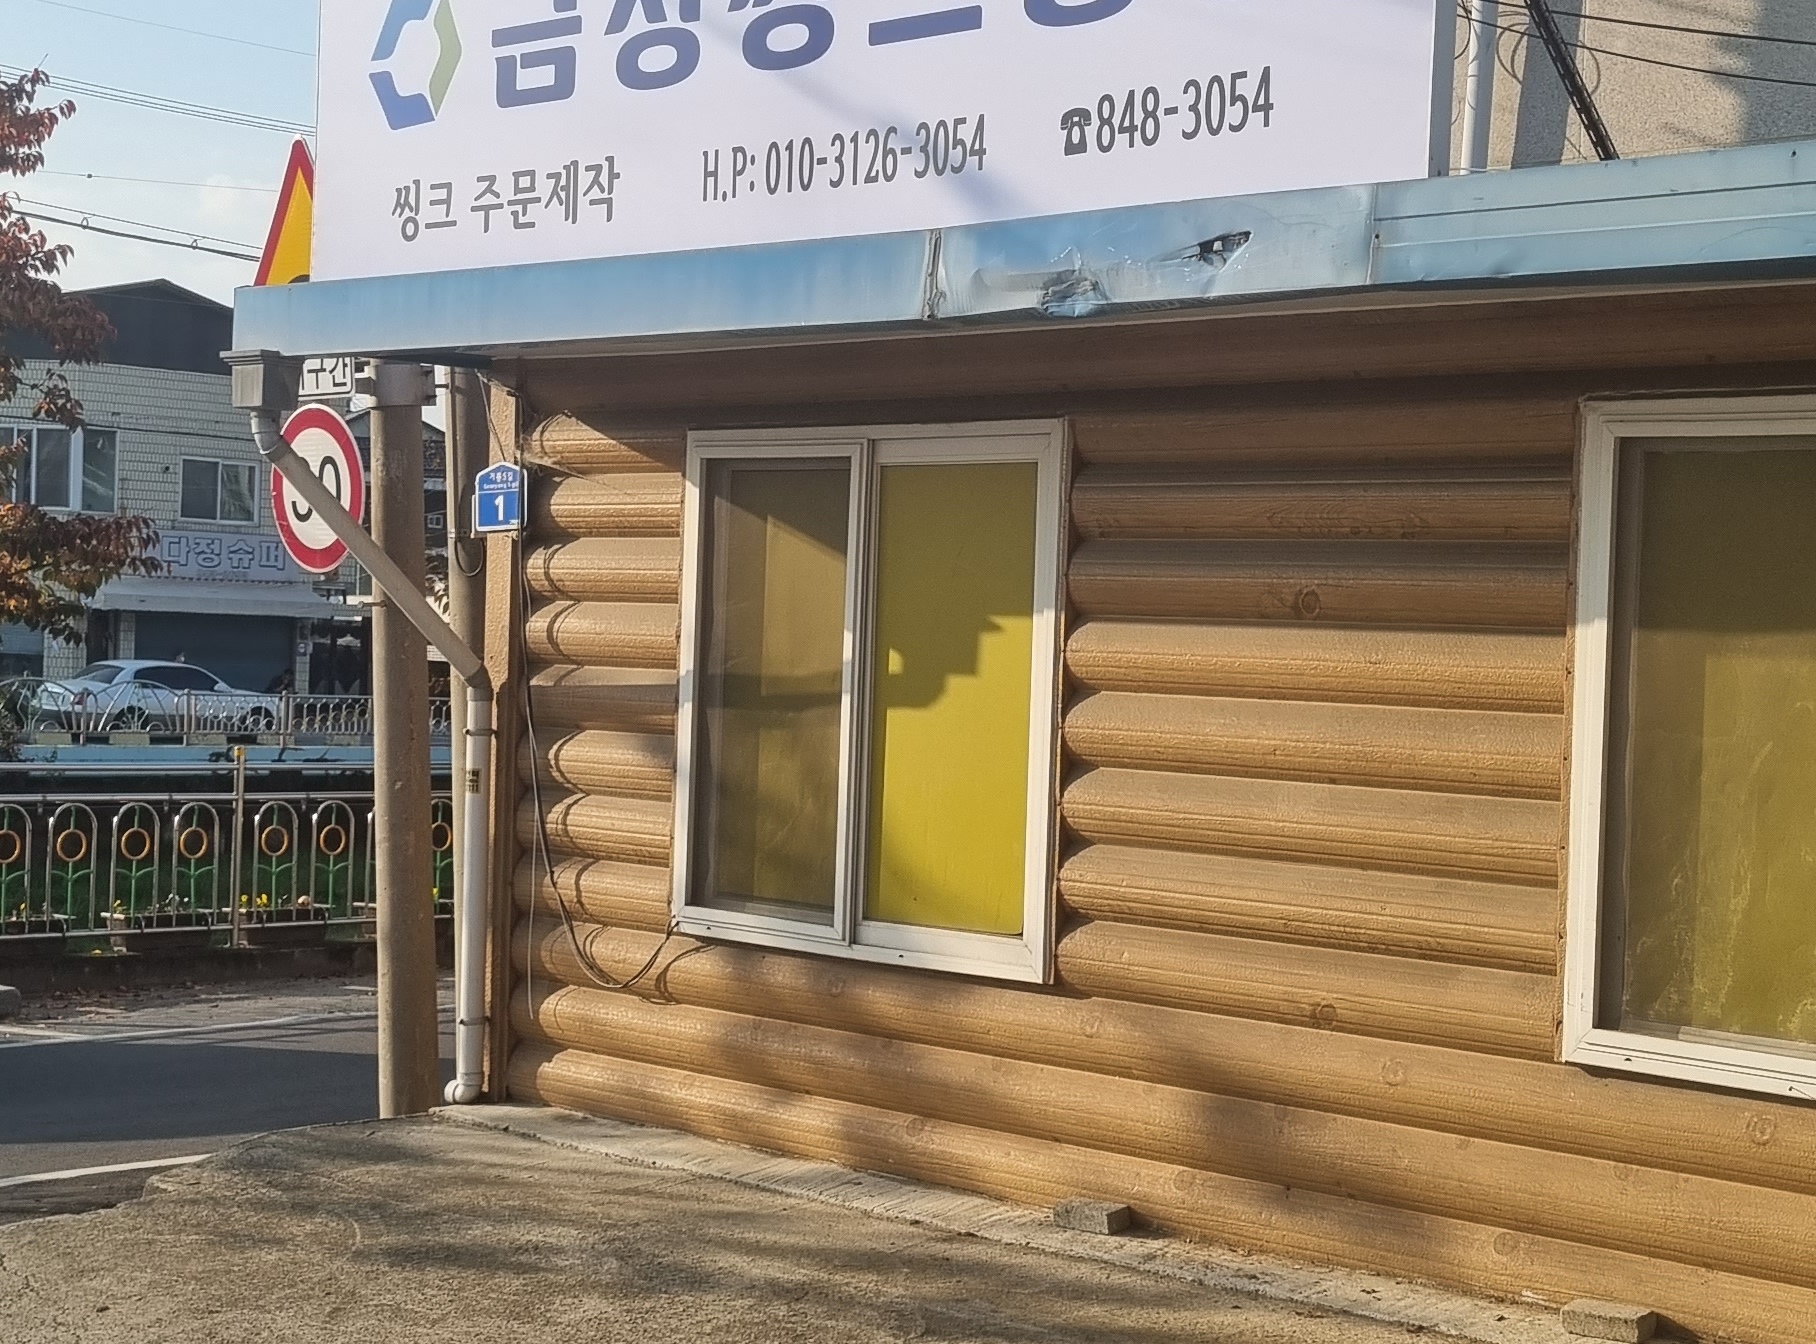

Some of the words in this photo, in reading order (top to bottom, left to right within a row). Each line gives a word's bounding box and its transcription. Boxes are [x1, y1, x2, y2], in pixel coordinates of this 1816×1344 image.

[1096, 65, 1275, 154] 848-3054
[702, 146, 757, 203] H.P:
[765, 113, 987, 196] 010-3126-3054
[391, 178, 457, 242] 씽크
[470, 155, 621, 233] 주문제작
[301, 357, 348, 391] 구간
[494, 494, 504, 522] 1
[161, 535, 286, 571] 다정슈퍼
